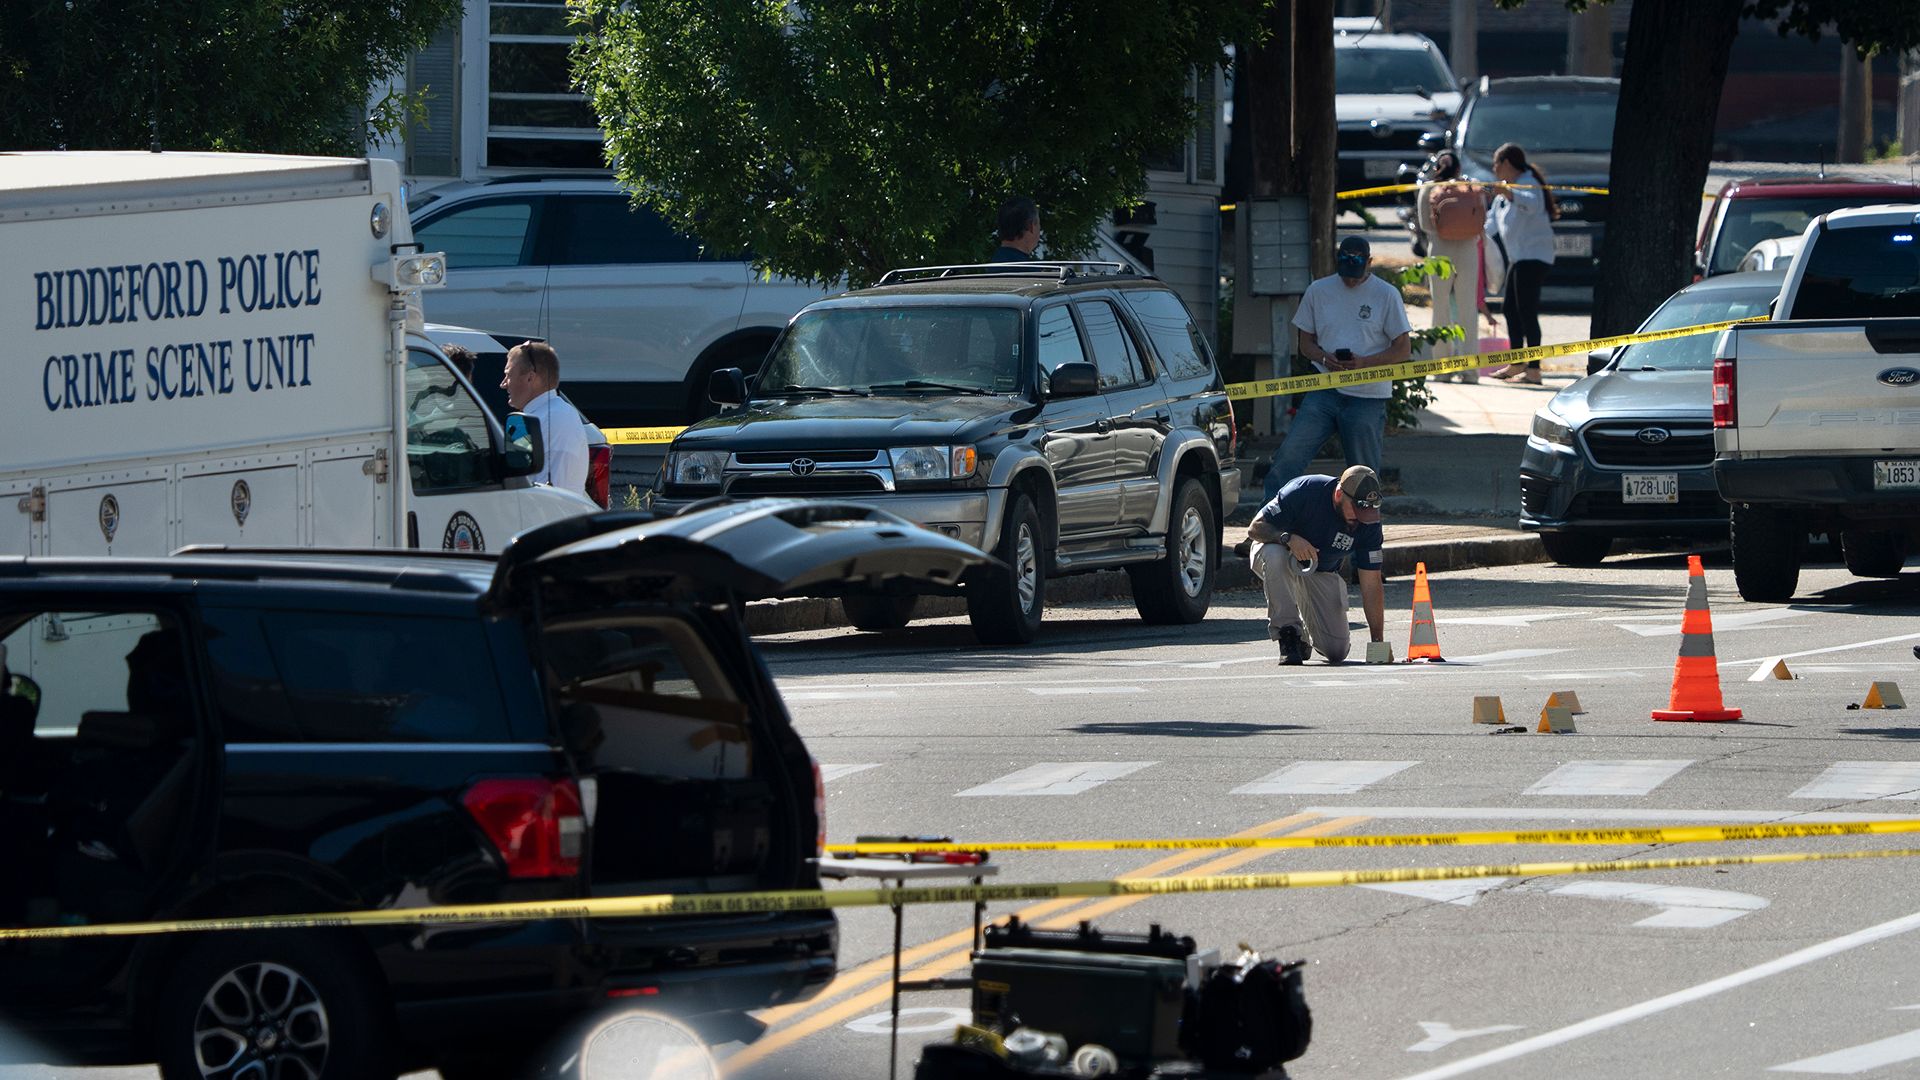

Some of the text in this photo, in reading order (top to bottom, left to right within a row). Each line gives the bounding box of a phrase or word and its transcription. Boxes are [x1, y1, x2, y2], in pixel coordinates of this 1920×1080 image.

[34, 249, 322, 331] BIDDEFORD POLICE
[43, 333, 315, 412] CRIME SCENE UNIT
[1887, 370, 1915, 383] Ford
[1887, 467, 1915, 484] 1853
[1334, 531, 1354, 546] FBI
